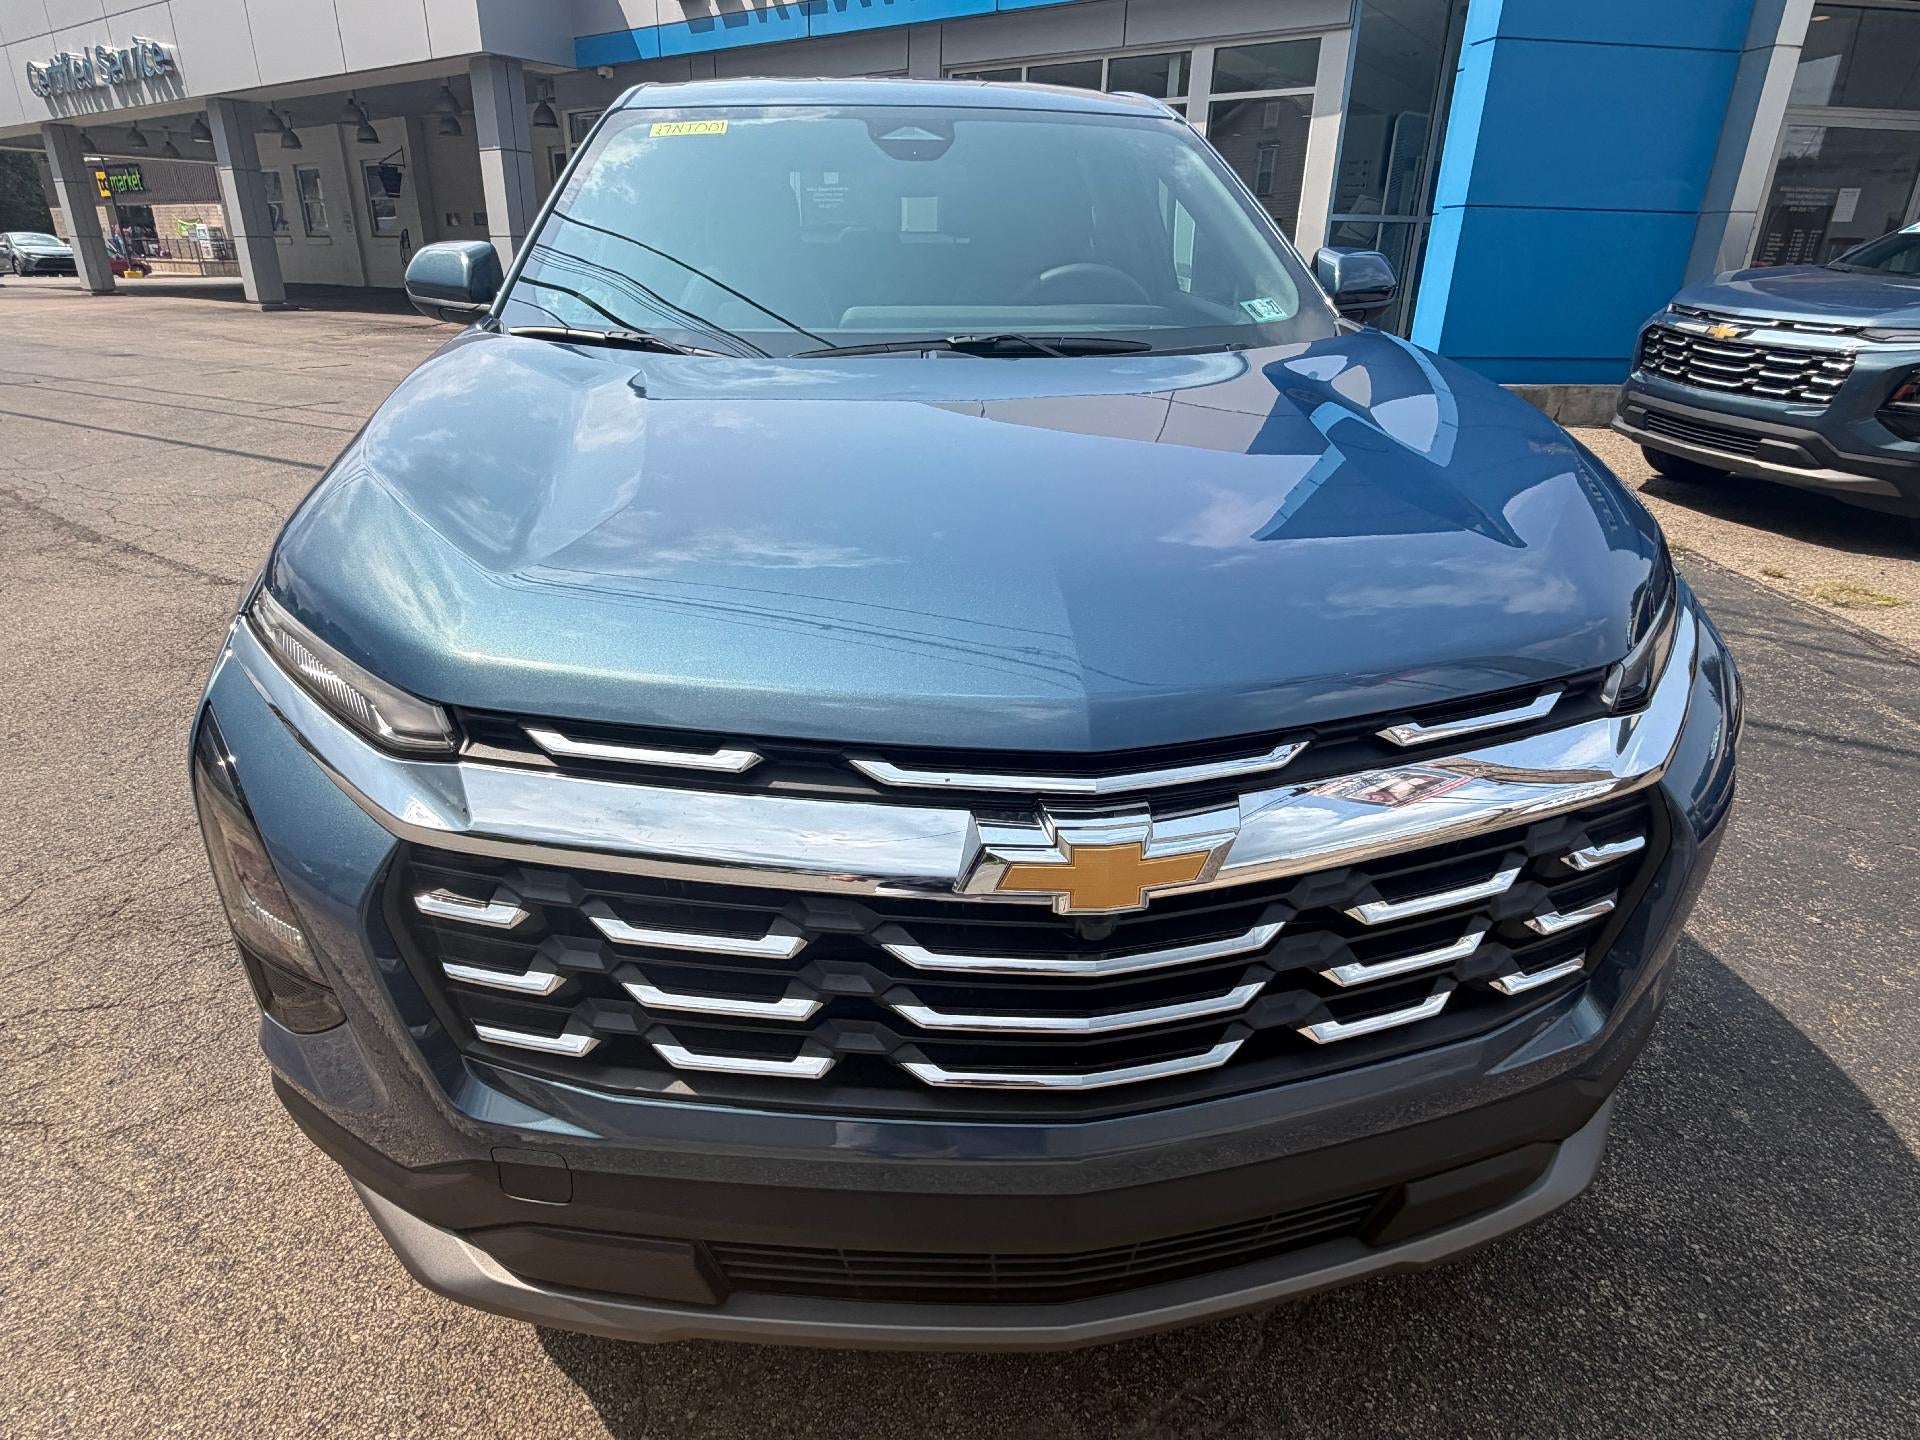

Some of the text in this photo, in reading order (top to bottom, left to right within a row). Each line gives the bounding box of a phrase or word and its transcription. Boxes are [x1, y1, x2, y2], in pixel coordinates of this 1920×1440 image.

[26, 36, 170, 97] Certified Service
[109, 168, 144, 193] market
